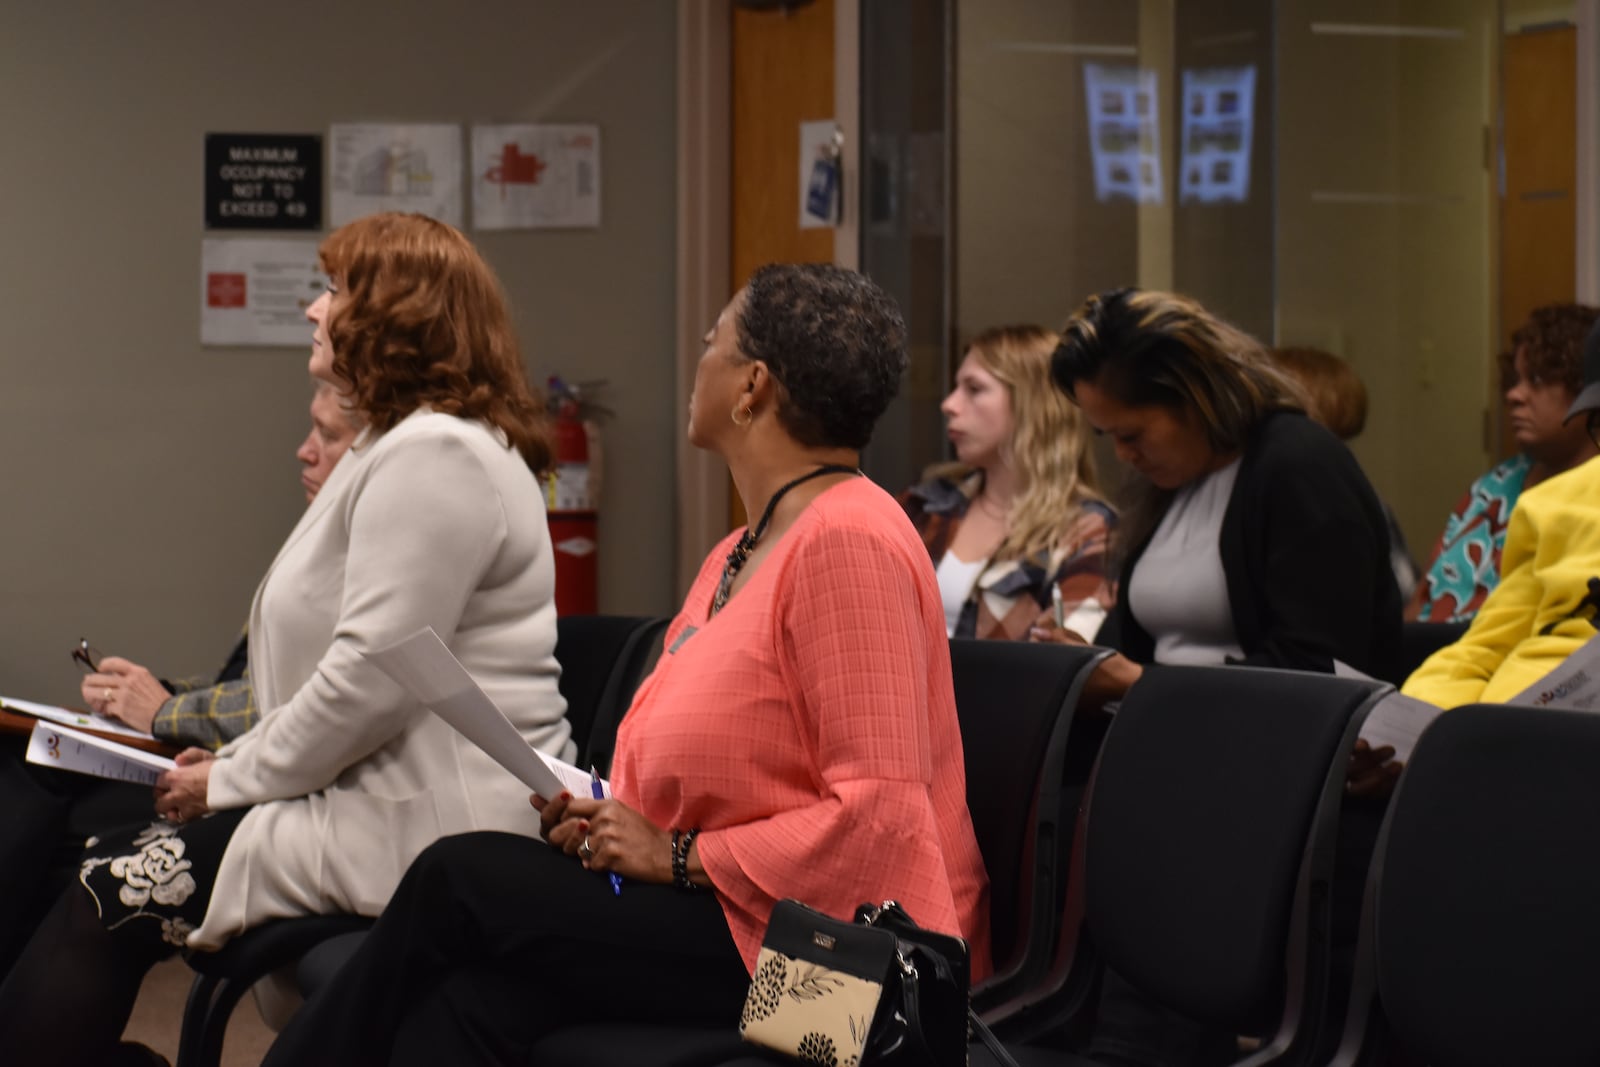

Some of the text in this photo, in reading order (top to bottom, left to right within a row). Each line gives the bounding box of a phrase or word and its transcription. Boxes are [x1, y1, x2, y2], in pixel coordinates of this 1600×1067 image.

[229, 147, 298, 161] MAXIMUM
[220, 165, 305, 180] OCCUPANCY
[233, 183, 294, 199] NOT TO
[220, 201, 278, 217] EXCEED
